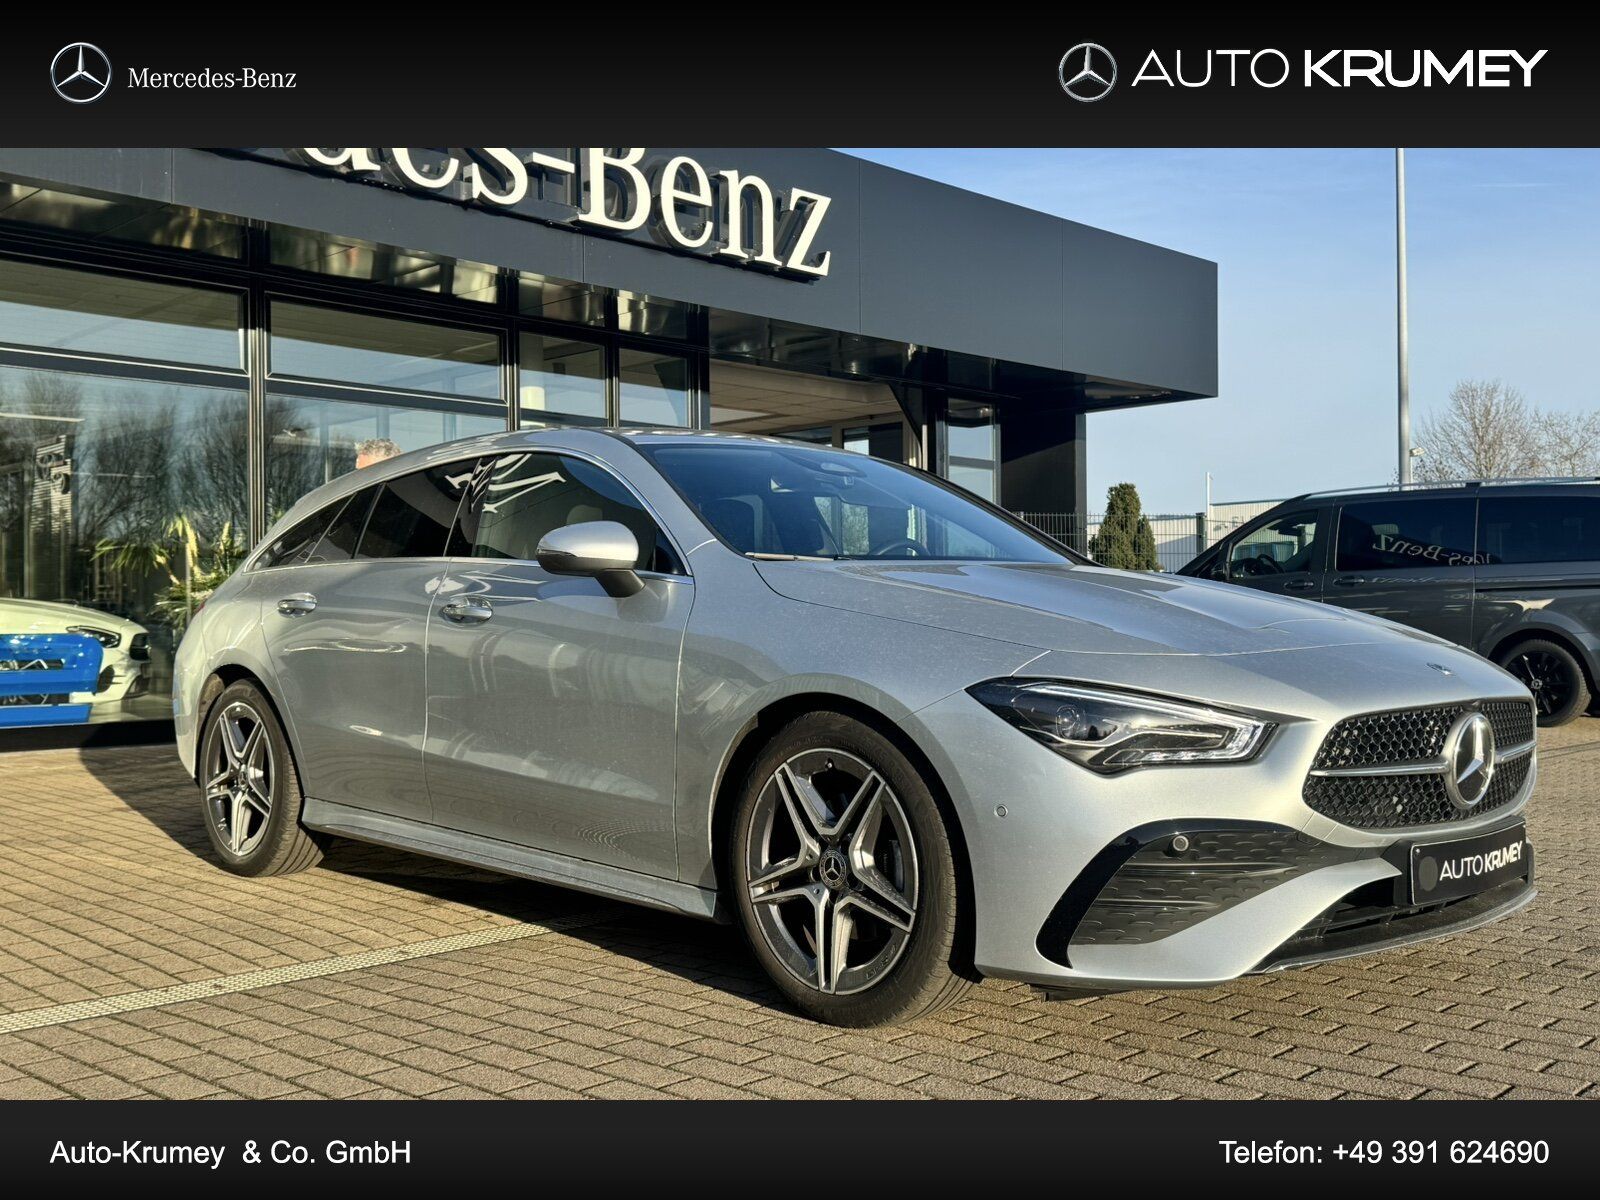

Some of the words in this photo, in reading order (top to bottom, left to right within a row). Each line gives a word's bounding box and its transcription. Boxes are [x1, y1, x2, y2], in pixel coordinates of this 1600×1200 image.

[304, 148, 832, 277] s-Benz
[1439, 854, 1484, 882] AUTO
[1484, 840, 1524, 873] KRUMEY
